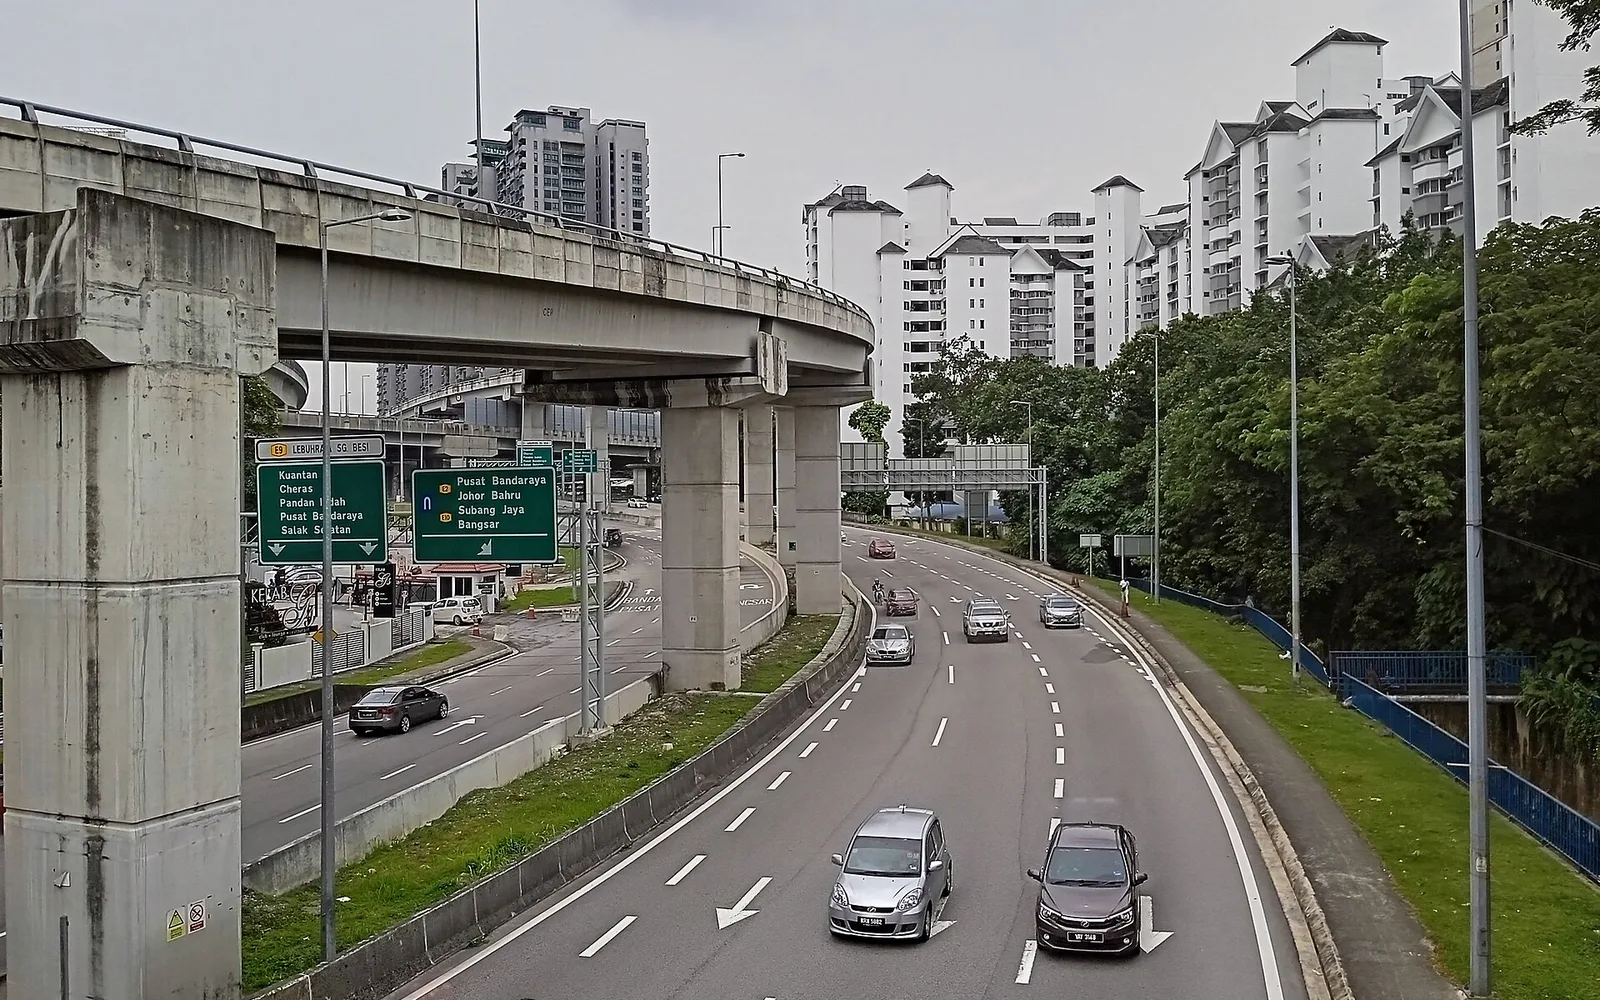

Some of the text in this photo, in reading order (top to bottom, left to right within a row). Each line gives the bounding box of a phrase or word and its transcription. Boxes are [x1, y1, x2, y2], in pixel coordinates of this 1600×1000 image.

[274, 445, 283, 454] E9
[292, 443, 332, 454] LEBUHRA
[352, 442, 369, 452] BESI
[279, 471, 318, 480] Kuantan
[457, 476, 547, 487] Pusat Bandaraya
[279, 484, 314, 494] Cheras
[457, 490, 521, 501] Johor Bahru
[280, 498, 315, 507] Pandan
[458, 505, 525, 516] Subang Jaya
[280, 511, 363, 522] Pusat Badaraya
[281, 525, 308, 535] Salak
[458, 519, 500, 530] Bangsar
[251, 586, 289, 604] KELAB
